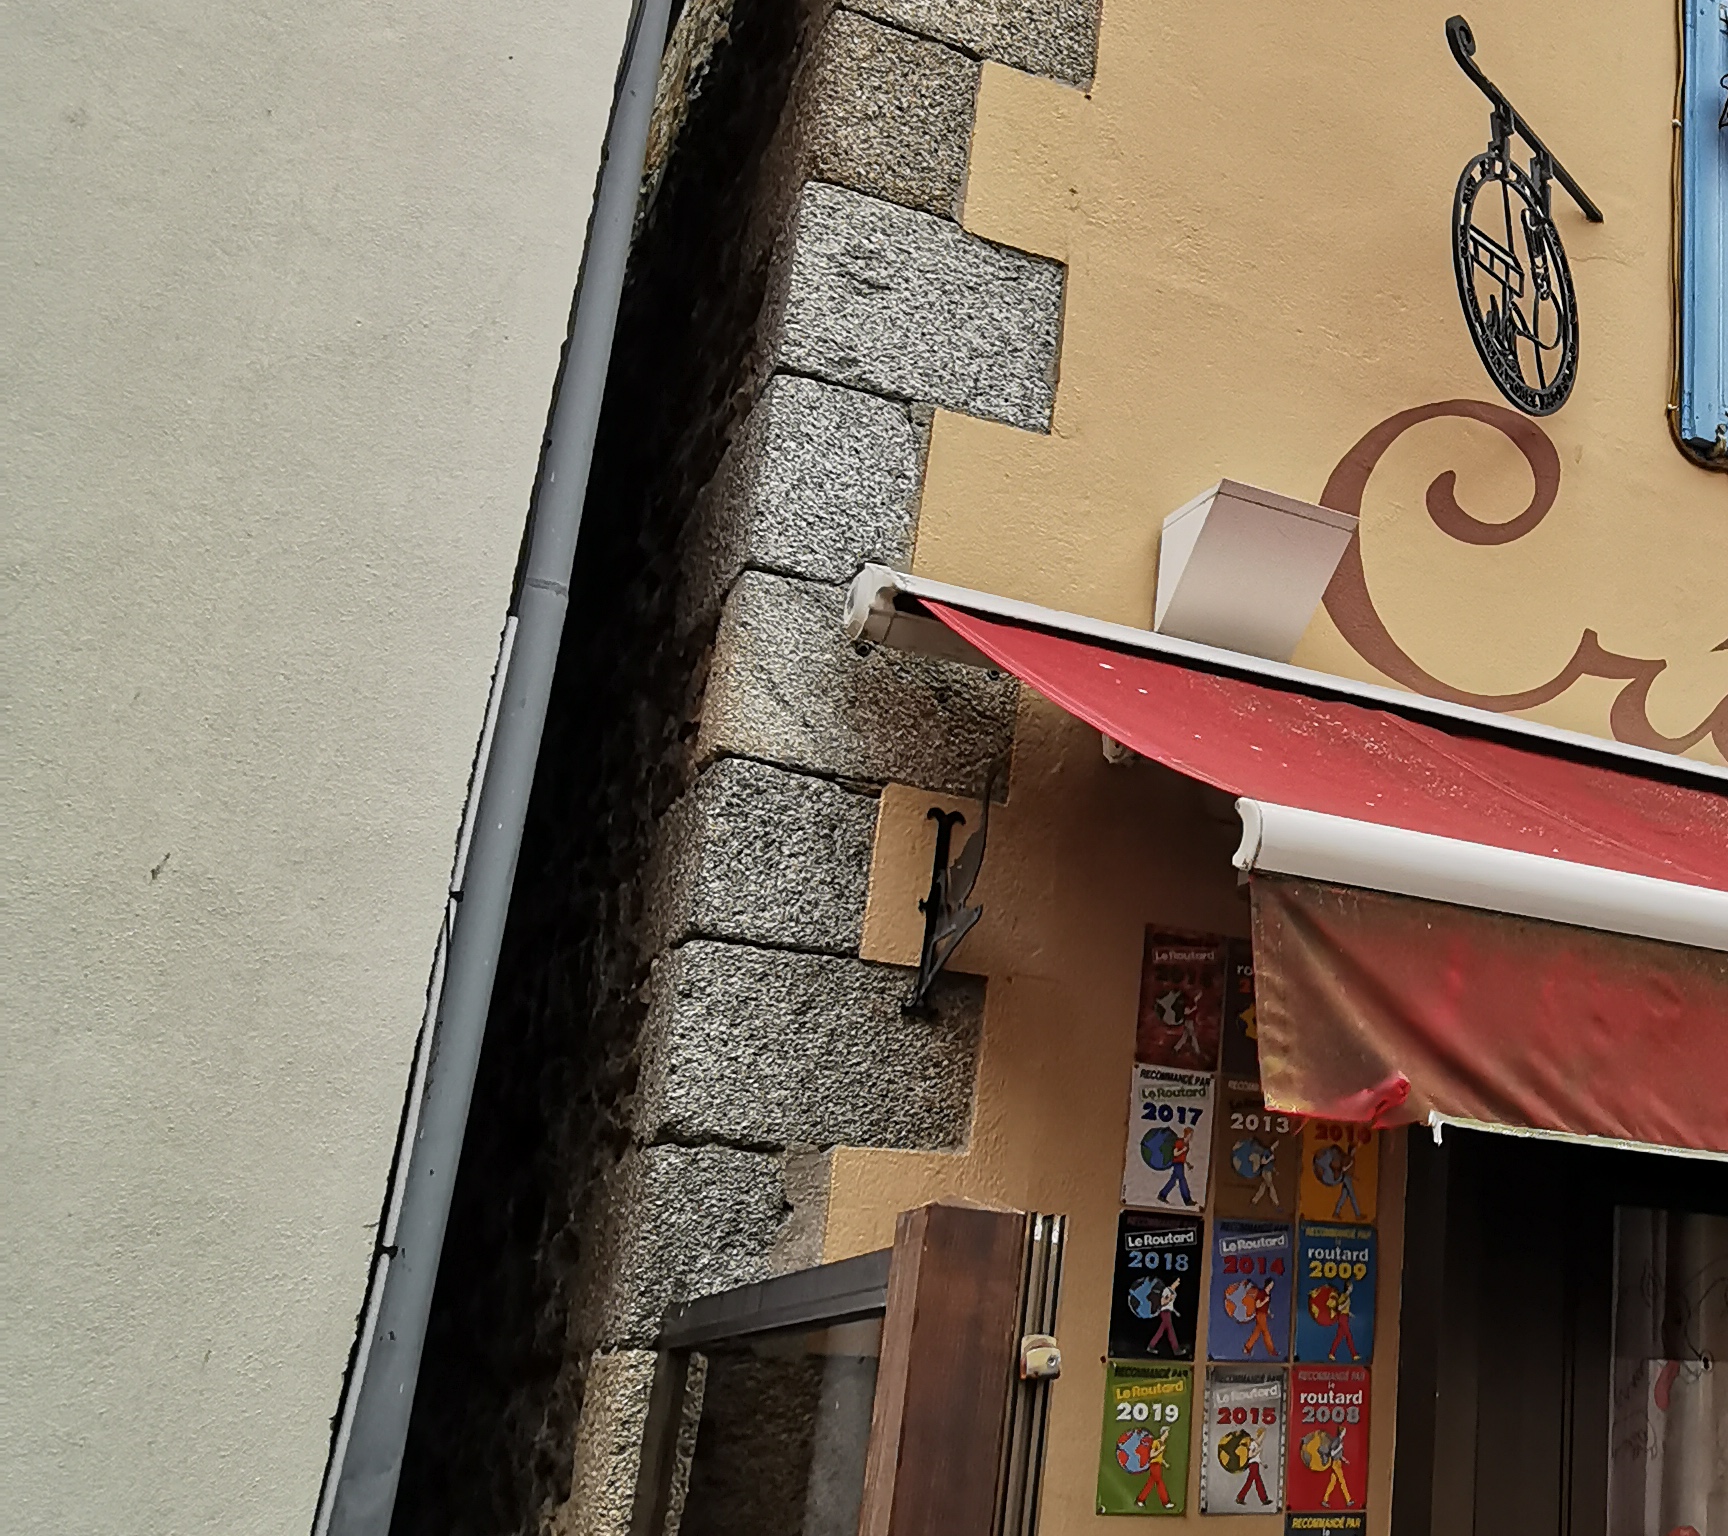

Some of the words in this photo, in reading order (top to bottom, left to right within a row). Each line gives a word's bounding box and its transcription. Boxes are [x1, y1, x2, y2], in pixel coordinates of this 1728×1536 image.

[1142, 1088, 1156, 1100] Le
[1157, 1086, 1206, 1099] Routard
[1141, 1102, 1203, 1125] 2017
[1230, 1114, 1290, 1133] 2013
[1128, 1234, 1143, 1248] Le
[1144, 1231, 1194, 1246] Routard
[1222, 1240, 1237, 1252] Le
[1237, 1235, 1285, 1250] Routard
[1128, 1251, 1189, 1271] 2018
[1307, 1246, 1369, 1262] routard
[1223, 1256, 1286, 1276] 2014
[1309, 1261, 1367, 1280] 2009
[1116, 1387, 1131, 1400] Le
[1132, 1381, 1184, 1397] Routard
[1216, 1392, 1230, 1404] Le
[1231, 1385, 1278, 1402] Routard
[1300, 1390, 1363, 1405] routard
[1116, 1403, 1180, 1423] 2019
[1217, 1406, 1277, 1425] 2015
[1302, 1406, 1361, 1424] 2008
